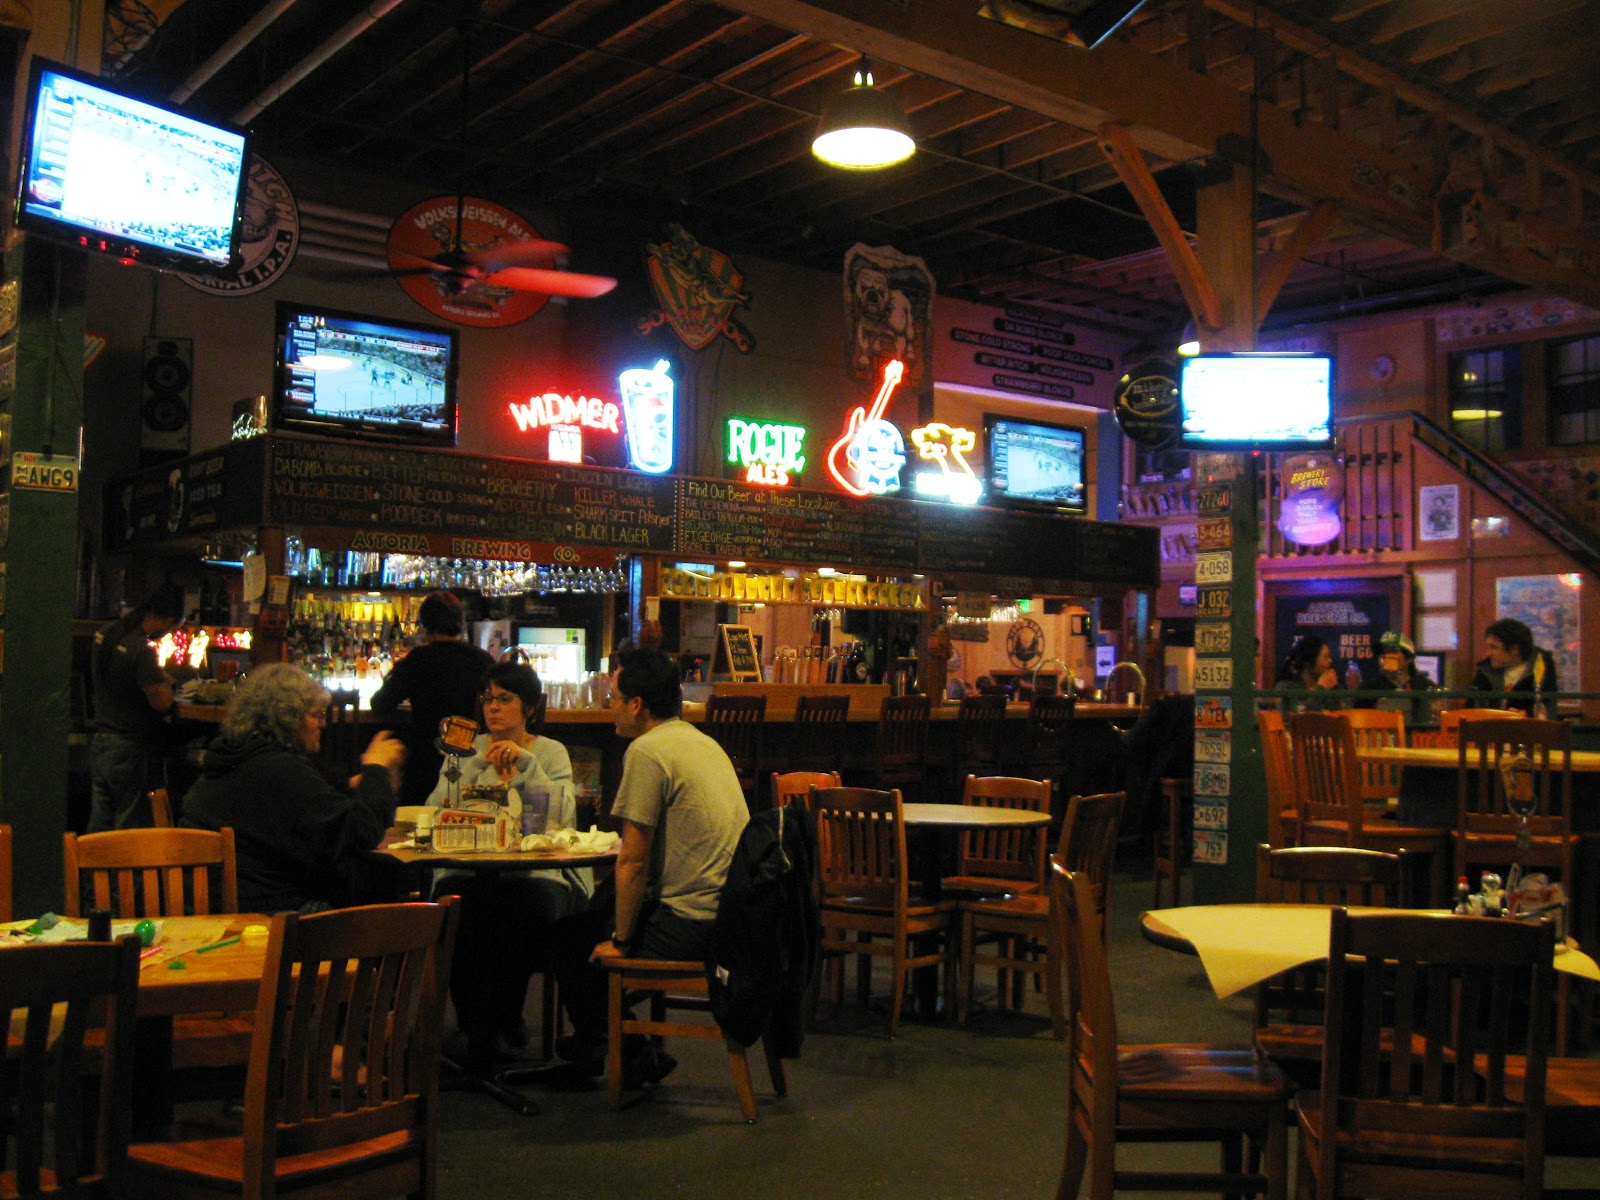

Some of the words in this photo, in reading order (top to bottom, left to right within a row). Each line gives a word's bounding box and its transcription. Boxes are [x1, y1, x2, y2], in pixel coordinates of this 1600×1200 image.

[509, 393, 619, 434] WIDMER
[728, 419, 806, 472] ROGUE
[29, 466, 74, 487] AWG9
[746, 463, 789, 486] ALES
[1291, 468, 1326, 485] BREWERY
[1299, 477, 1330, 491] STORE
[382, 483, 425, 504] STONE
[426, 489, 454, 504] COLD
[574, 487, 617, 507] KILLER
[688, 482, 709, 498] Find
[710, 484, 727, 499] Our
[728, 485, 750, 502] Beer
[754, 492, 766, 503] at
[769, 490, 797, 508] These
[573, 503, 606, 523] SHARK
[574, 521, 608, 541] BLACK
[611, 525, 650, 547] LAGER
[350, 532, 431, 553] ASTORIA
[451, 537, 531, 560] BREWING
[1340, 634, 1371, 646] BEER
[1339, 646, 1355, 657] TO
[1195, 666, 1229, 682] 45132
